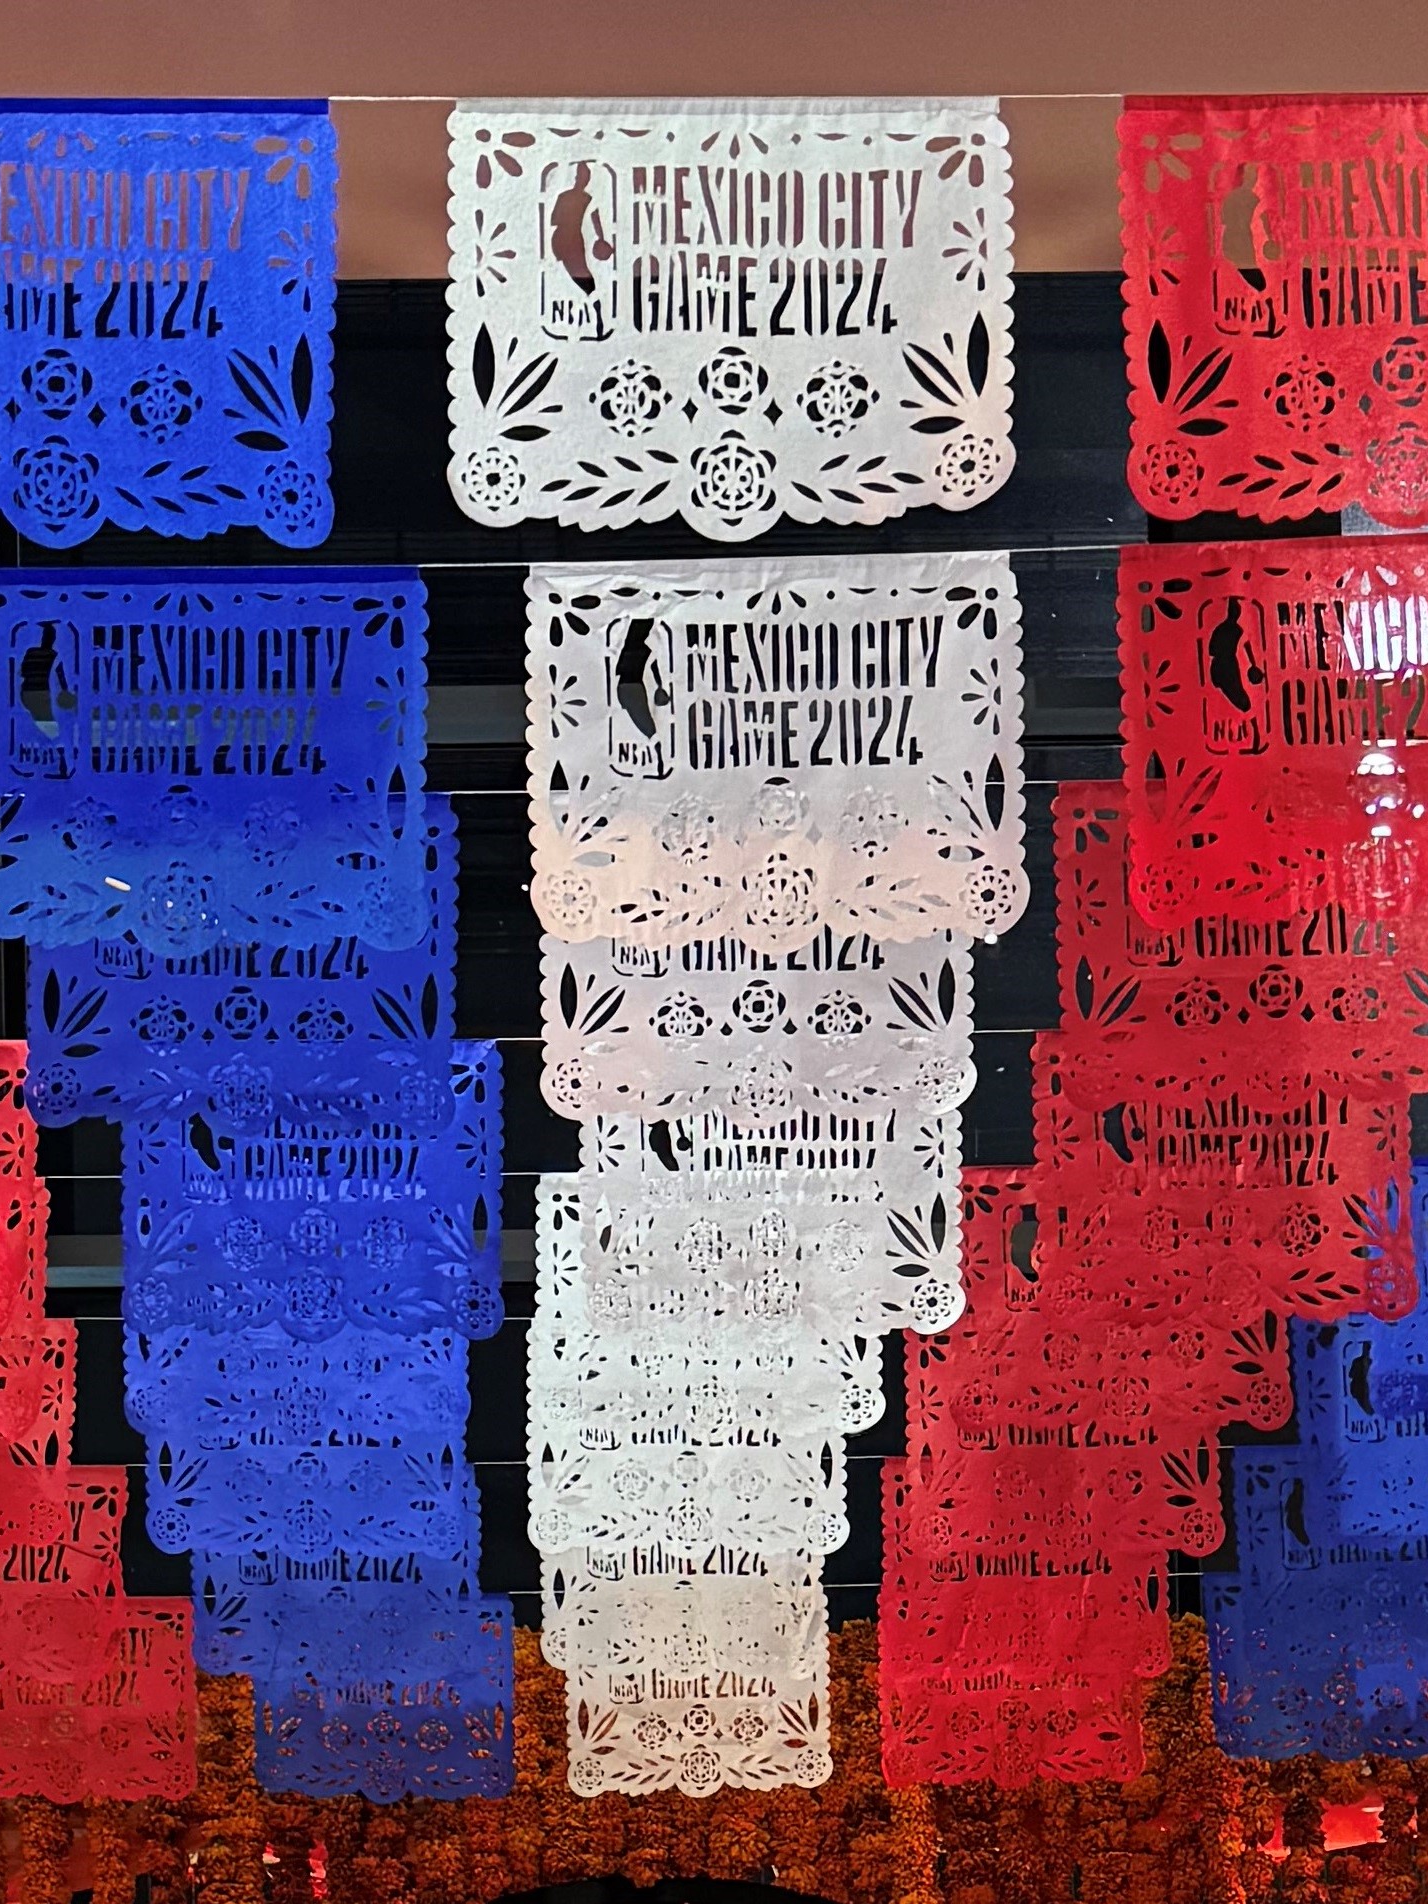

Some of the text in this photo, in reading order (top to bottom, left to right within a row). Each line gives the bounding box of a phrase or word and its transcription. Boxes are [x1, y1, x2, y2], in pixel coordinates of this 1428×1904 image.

[142, 167, 252, 252] CITY
[632, 163, 923, 250] MEXICO CITY
[93, 258, 225, 340] 2024
[632, 252, 900, 338] GAME 2024
[1300, 243, 1427, 330] GAME
[91, 623, 352, 697] MEXICO CITY
[685, 614, 945, 694] MEXICO CITY
[91, 703, 328, 777] GAME 2024
[686, 695, 924, 770] GAME 2024
[1280, 673, 1394, 747] GAME
[1195, 901, 1398, 961] GAME 2024
[2, 1542, 72, 1583] 2024
